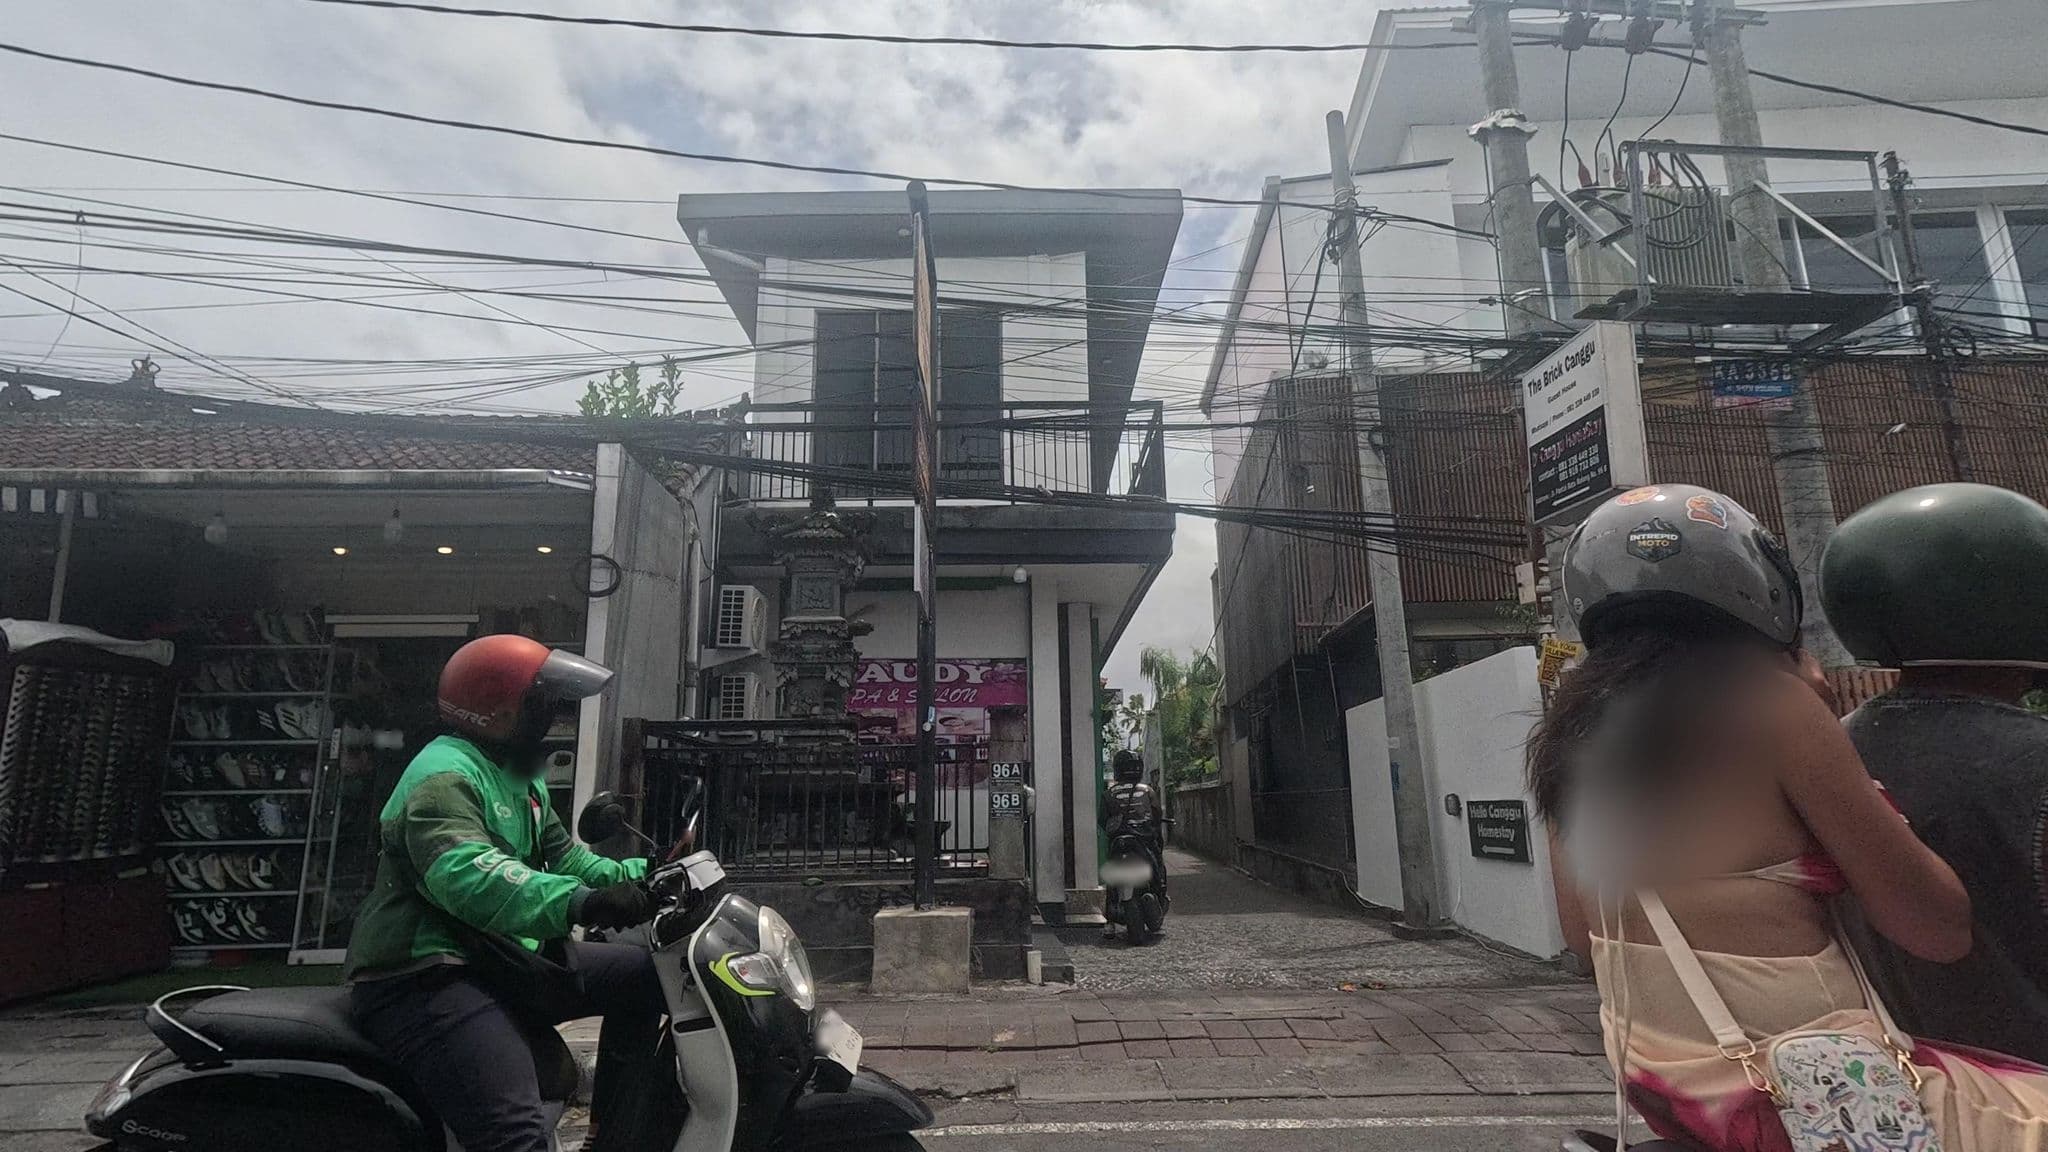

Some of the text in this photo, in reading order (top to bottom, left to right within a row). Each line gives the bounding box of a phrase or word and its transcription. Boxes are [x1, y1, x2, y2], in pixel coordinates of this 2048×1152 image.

[1528, 341, 1595, 397] The Brick Canggu
[1547, 380, 1577, 404] Guest House
[1629, 533, 1679, 542] INTREPID
[1638, 539, 1669, 547] MOTO
[851, 687, 978, 704] PA & SLON
[1488, 804, 1521, 821] Canggu
[1477, 823, 1515, 842] Homestay
